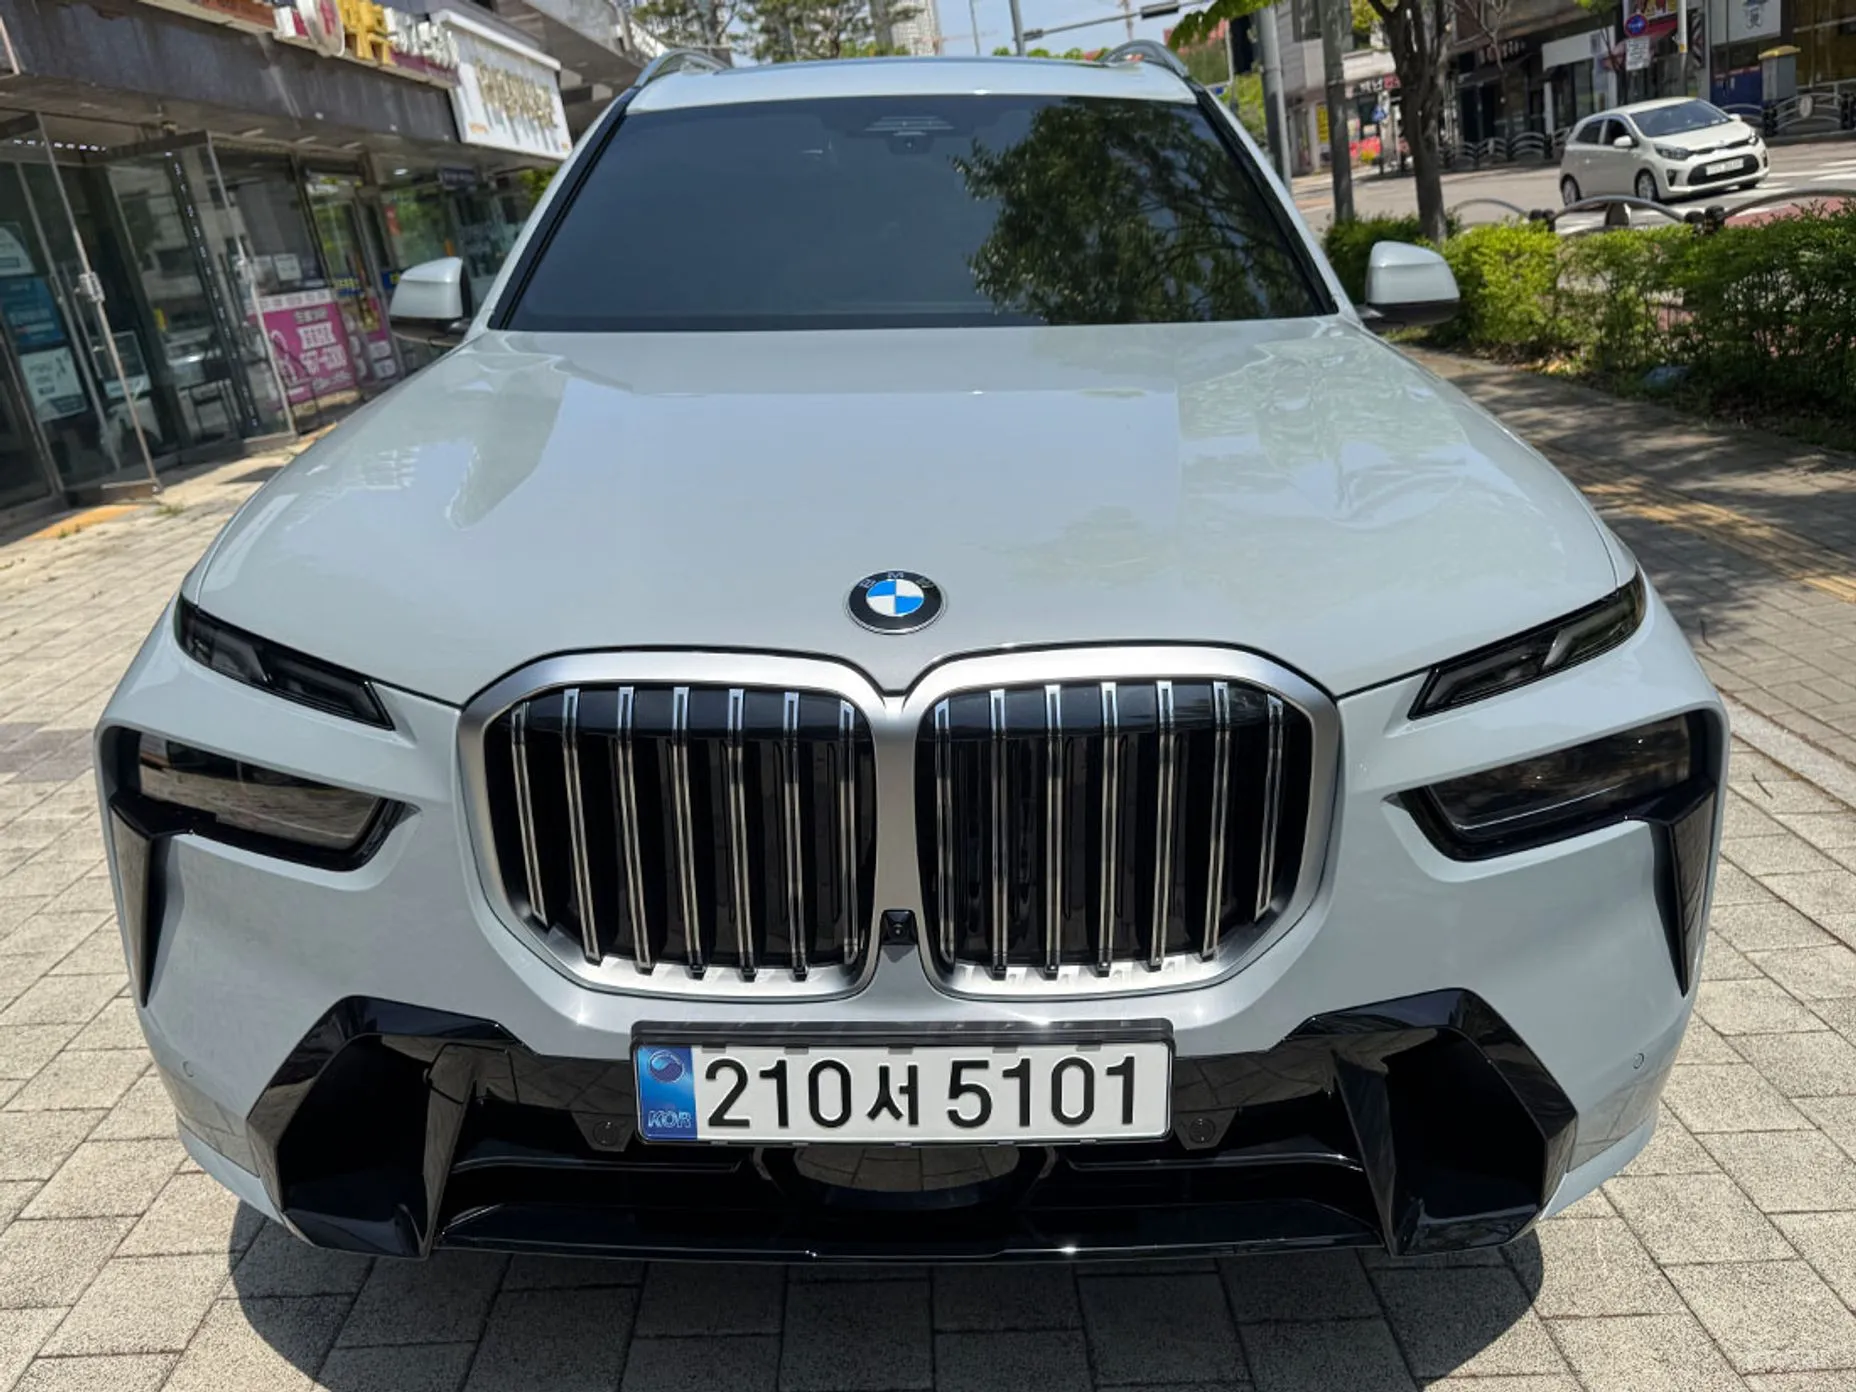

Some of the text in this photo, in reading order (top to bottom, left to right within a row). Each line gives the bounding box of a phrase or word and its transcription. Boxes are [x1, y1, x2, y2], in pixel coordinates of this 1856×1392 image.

[858, 571, 935, 589] BMW
[704, 1055, 1136, 1129] 210서 5101
[647, 1109, 693, 1129] KOR
